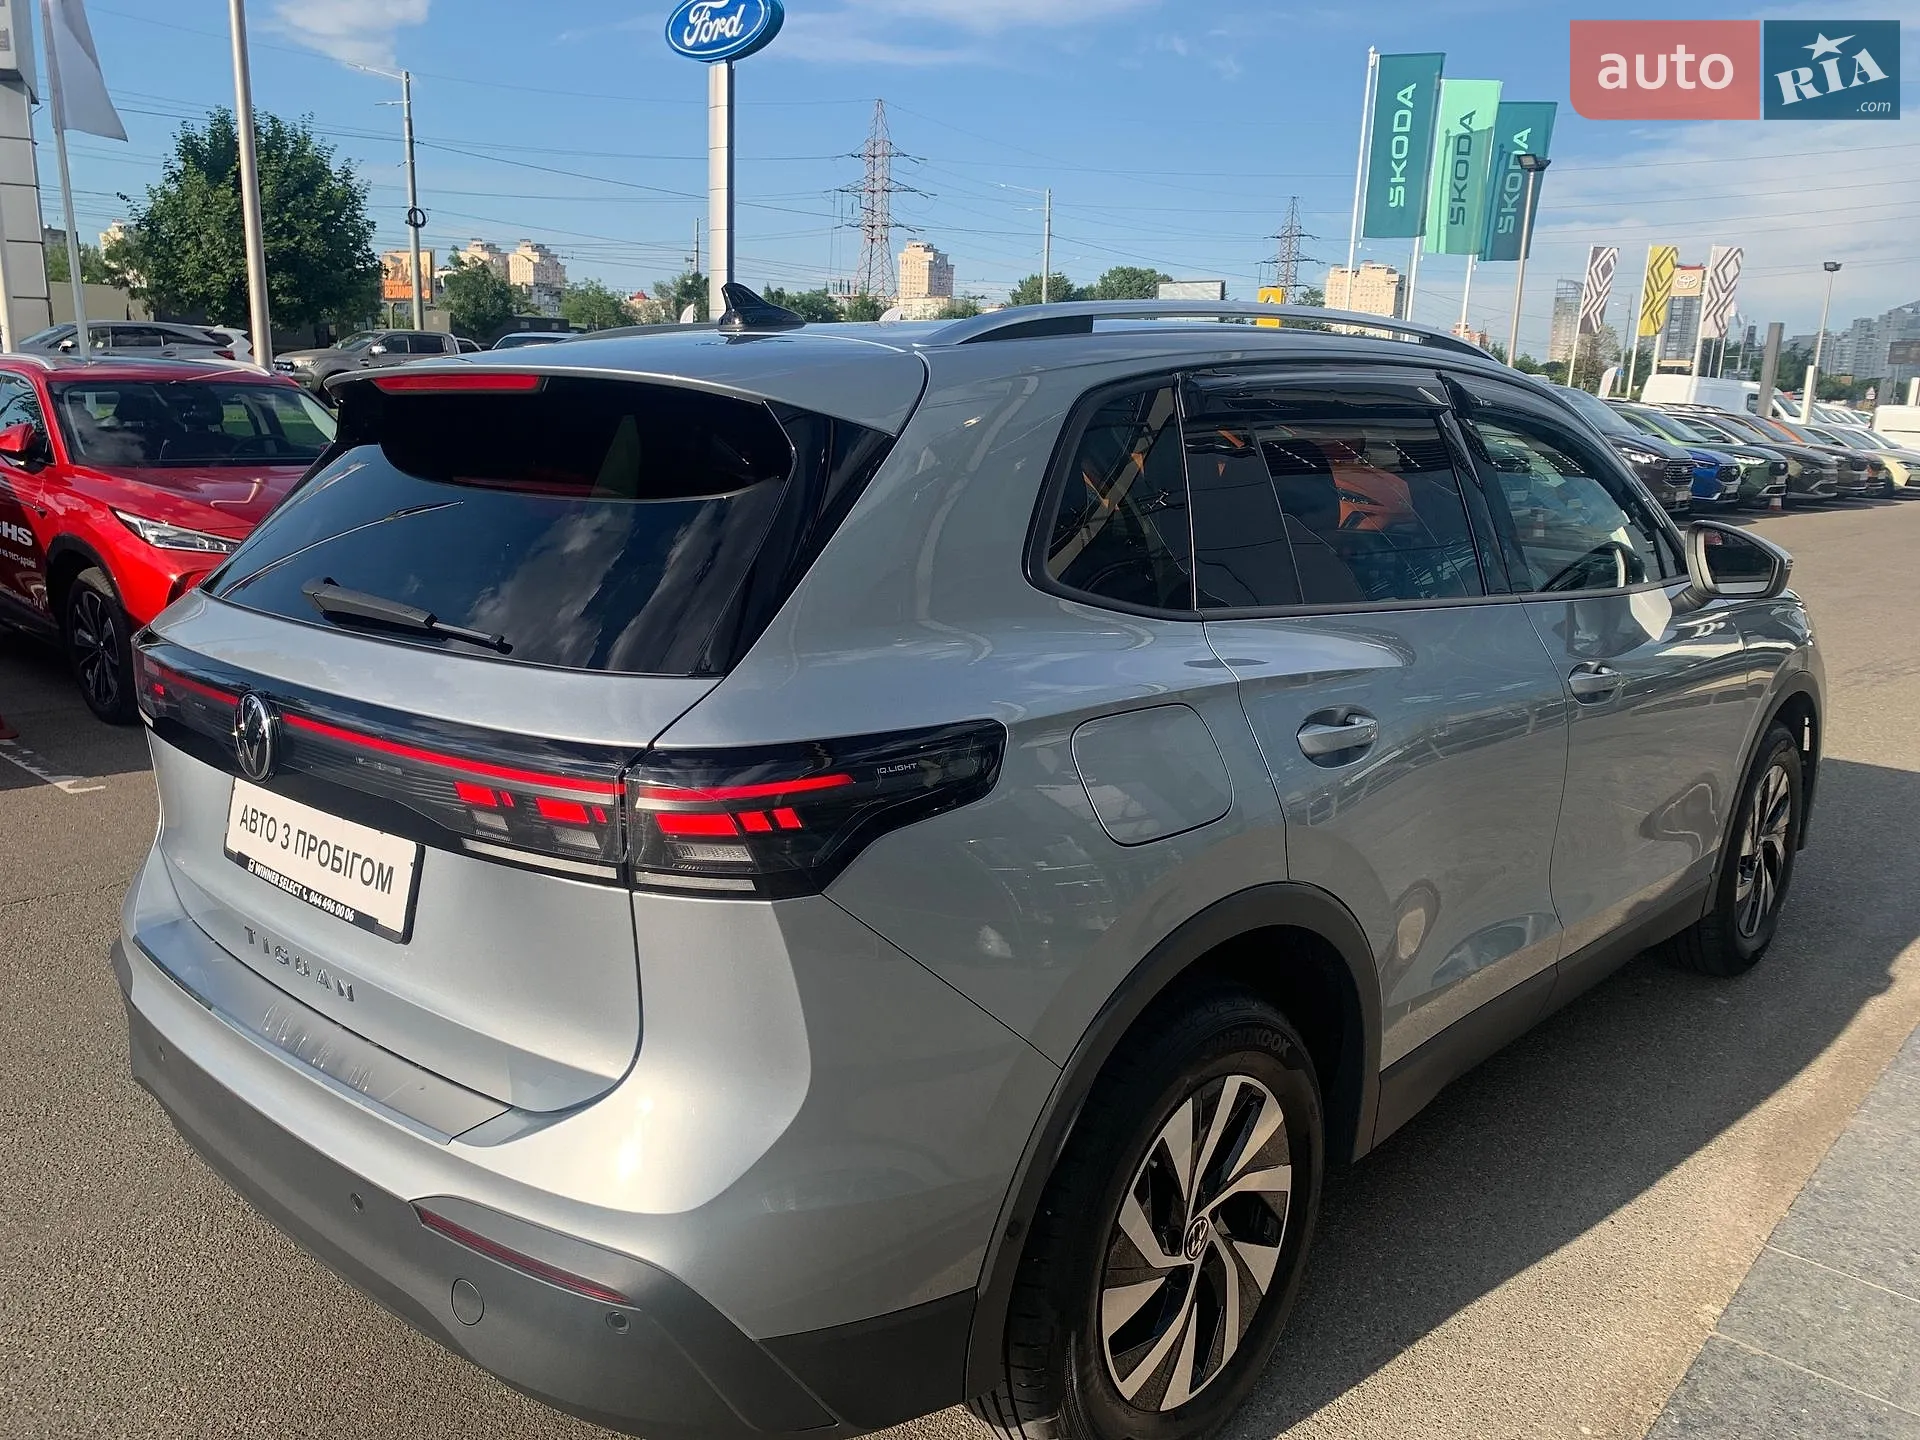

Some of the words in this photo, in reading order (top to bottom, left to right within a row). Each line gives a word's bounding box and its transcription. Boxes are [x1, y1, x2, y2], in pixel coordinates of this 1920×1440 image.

[684, 0, 745, 46] Ford
[0, 521, 33, 547] HS
[876, 762, 918, 774] IQ.LIGHT
[239, 804, 278, 843] АВТО
[294, 829, 395, 895] ПРОБІГОМ
[255, 862, 279, 886] WINNER
[279, 875, 302, 896] SELECT
[309, 891, 322, 906] 044
[322, 897, 335, 913] 496
[335, 903, 345, 918] 00
[345, 909, 355, 922] 06
[244, 926, 355, 1002] TIGUAN
